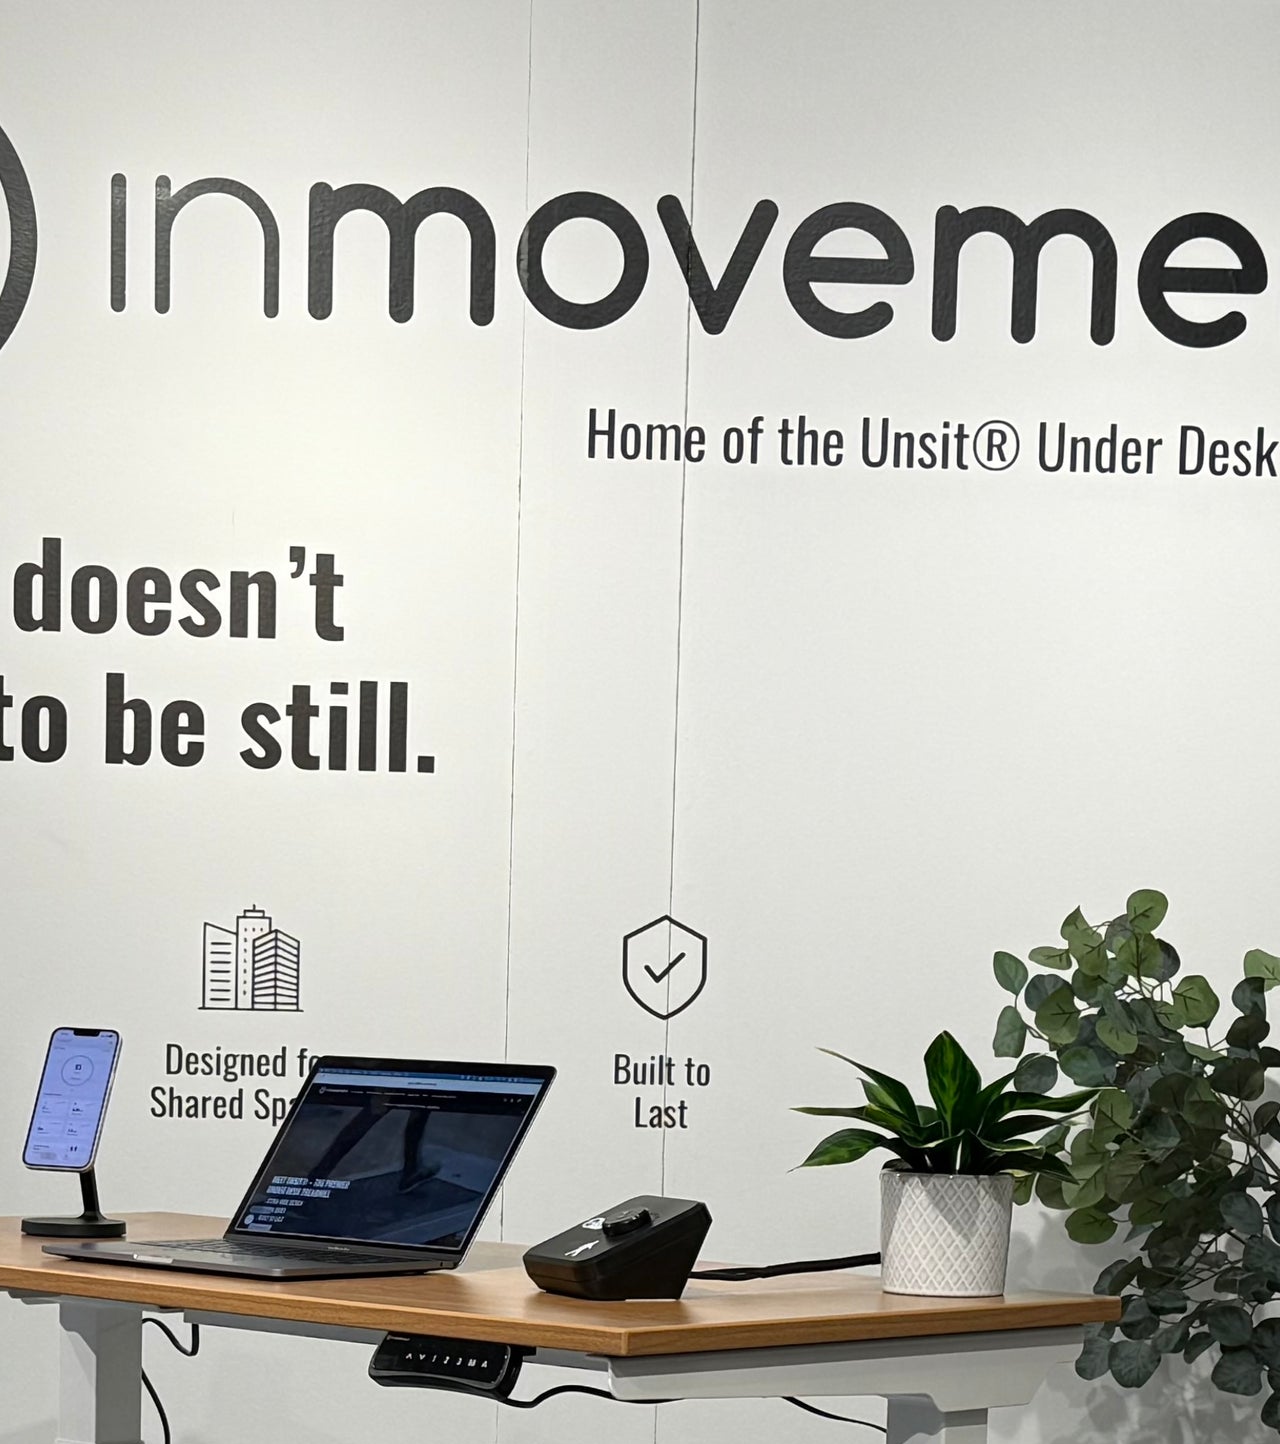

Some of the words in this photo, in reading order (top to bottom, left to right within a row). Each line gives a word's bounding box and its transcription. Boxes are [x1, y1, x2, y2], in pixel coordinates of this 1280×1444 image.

[589, 409, 705, 462] Home
[724, 416, 763, 464] of
[778, 416, 843, 466] the
[1039, 422, 1162, 474] Under
[1179, 426, 1278, 477] Desk
[14, 538, 343, 641] doesn’t
[106, 673, 204, 766] be
[240, 681, 434, 773] still.
[166, 1043, 287, 1082] Designed
[614, 1051, 674, 1085] Built
[685, 1058, 710, 1086] to
[151, 1086, 244, 1120] Shared
[635, 1097, 687, 1128] Last
